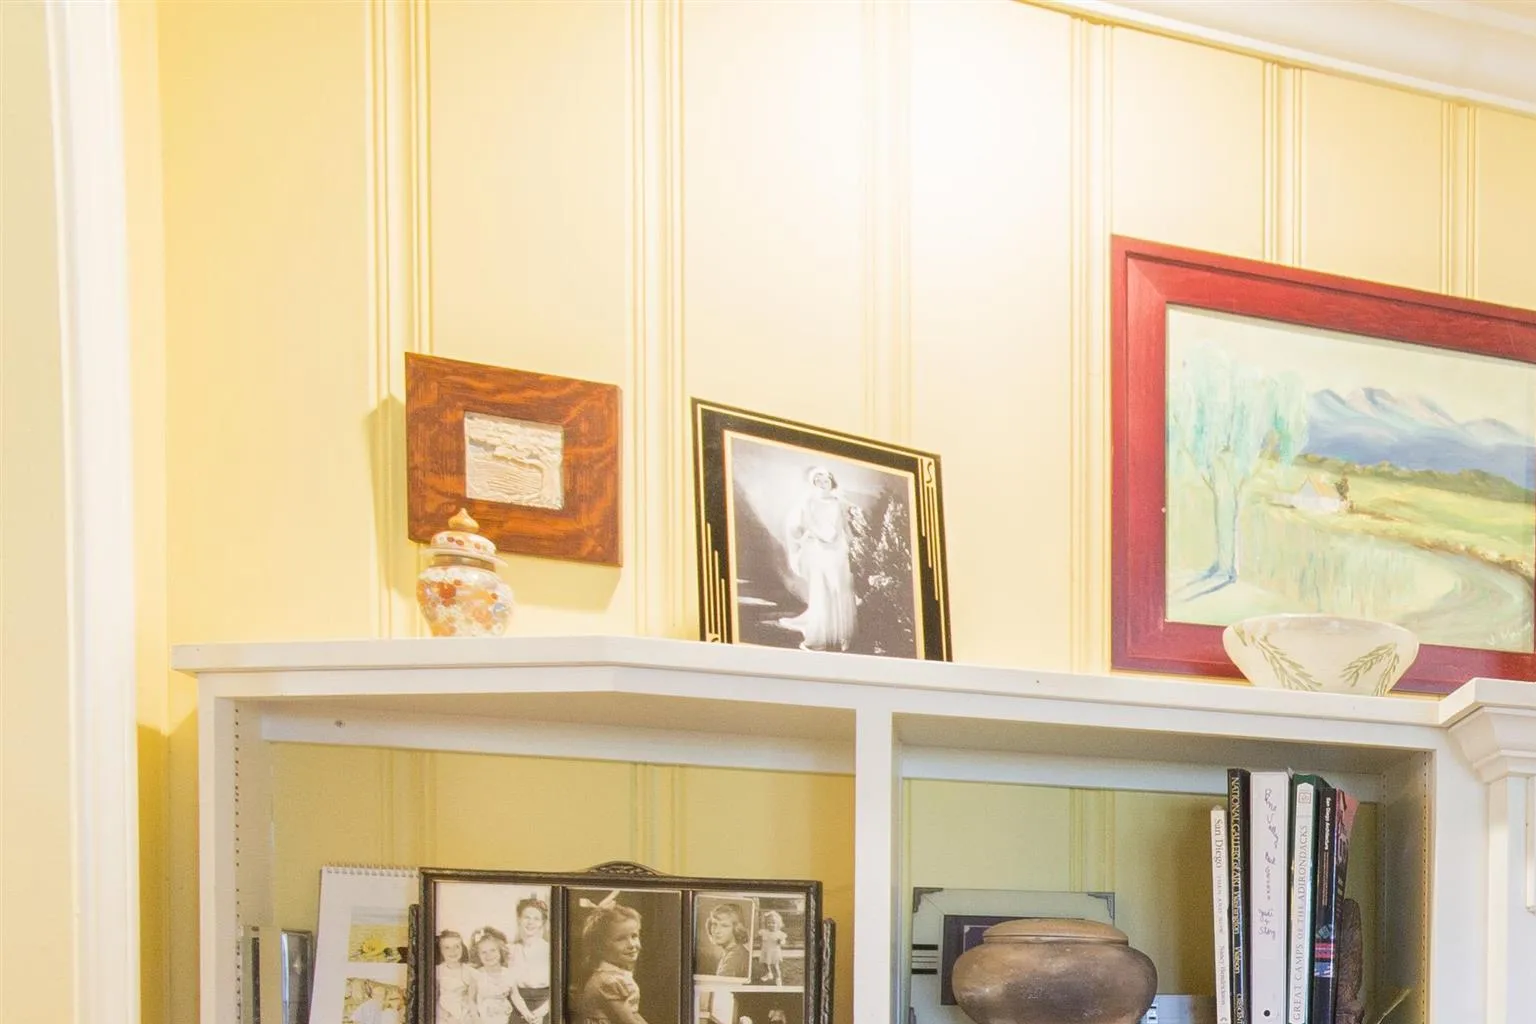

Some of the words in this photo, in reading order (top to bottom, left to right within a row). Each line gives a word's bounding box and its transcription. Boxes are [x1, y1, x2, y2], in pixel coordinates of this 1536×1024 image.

[1231, 777, 1241, 820] NATIONAL
[1214, 818, 1223, 836] San
[1231, 823, 1241, 862] GALLERY
[1214, 840, 1224, 868] Diego
[1298, 825, 1307, 900] ADIRONDACKS
[1232, 870, 1242, 888] ART
[1297, 906, 1305, 924] THE
[1297, 930, 1304, 940] OF
[1294, 944, 1303, 981] CAMPS
[1294, 985, 1302, 1021] GREAT
